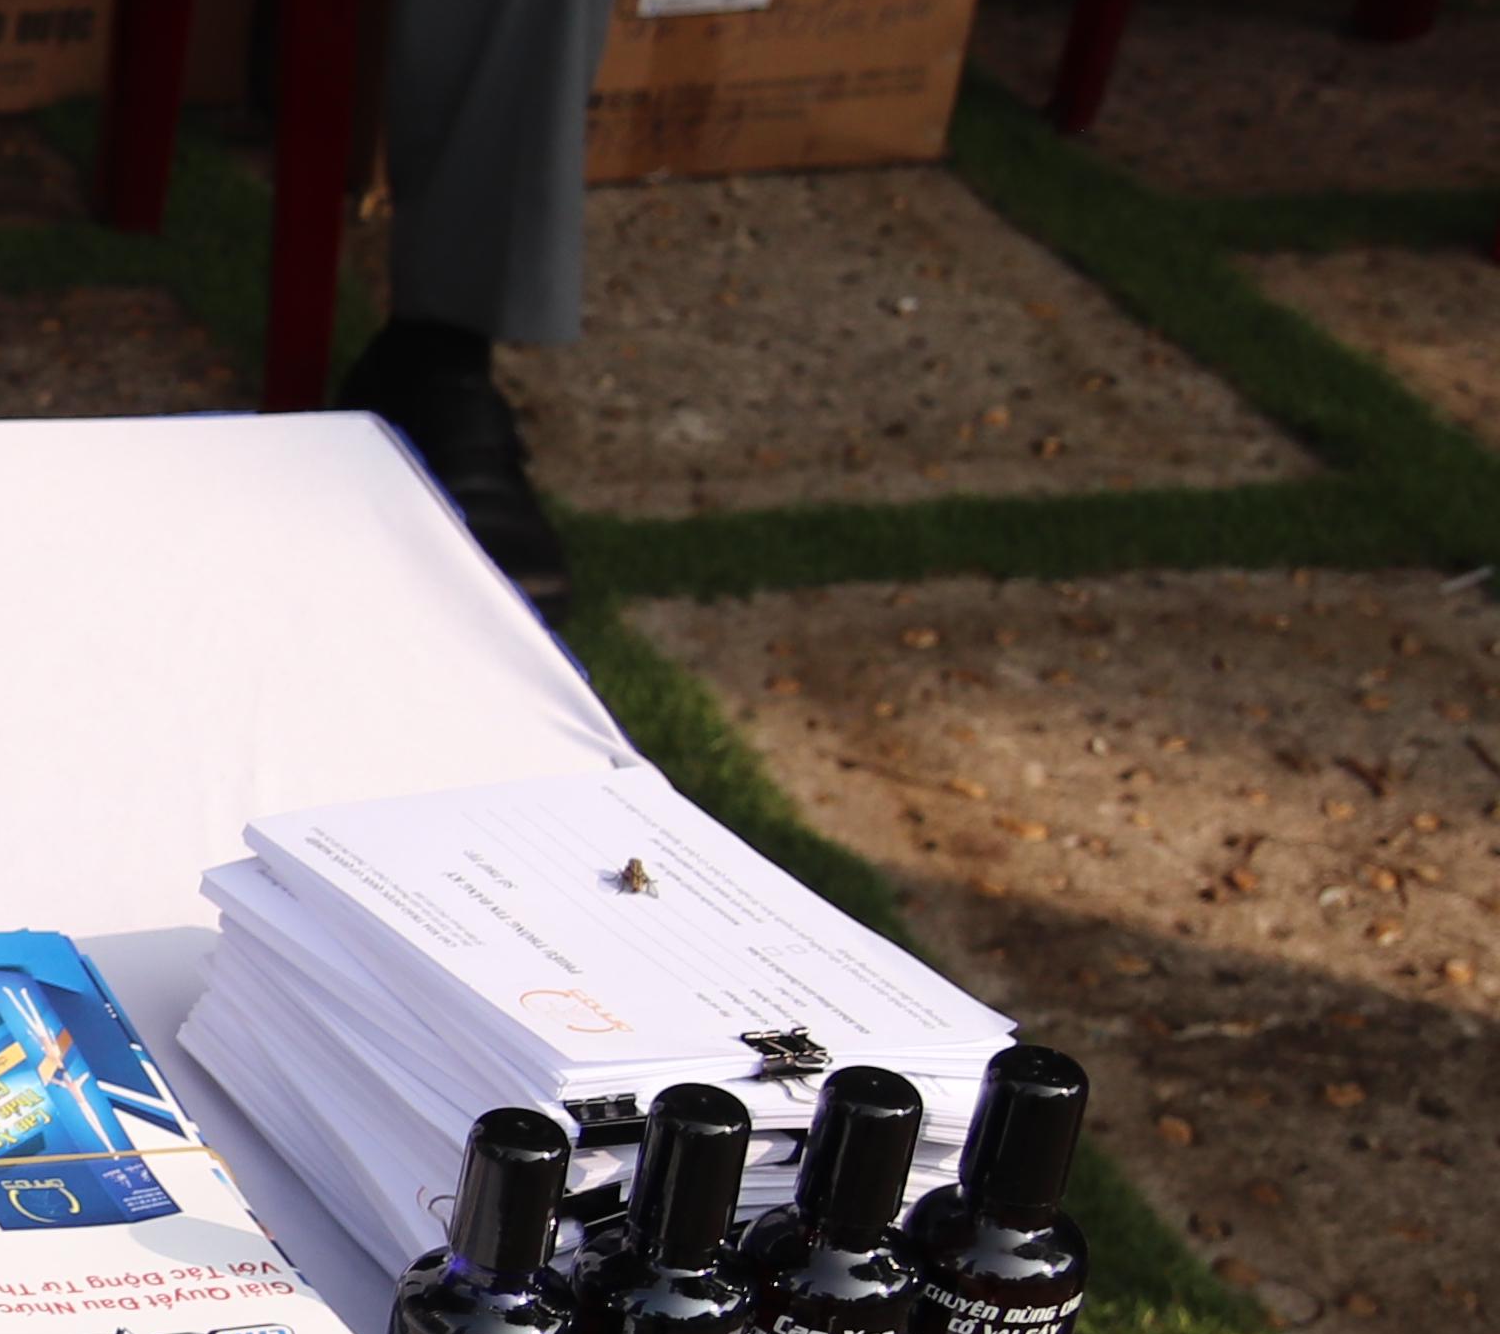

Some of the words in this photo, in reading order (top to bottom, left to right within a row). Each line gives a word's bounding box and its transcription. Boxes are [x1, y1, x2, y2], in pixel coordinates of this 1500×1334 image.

[169, 1265, 220, 1283] Tác
[228, 1259, 283, 1277] Với
[41, 1279, 82, 1295] Từ
[86, 1271, 162, 1290] Động
[237, 1279, 294, 1297] Giải
[83, 1297, 139, 1313] Đau
[146, 1286, 230, 1308] Quyết
[923, 1283, 999, 1321] CHUYÊN
[1003, 1304, 1057, 1324] DÙNG
